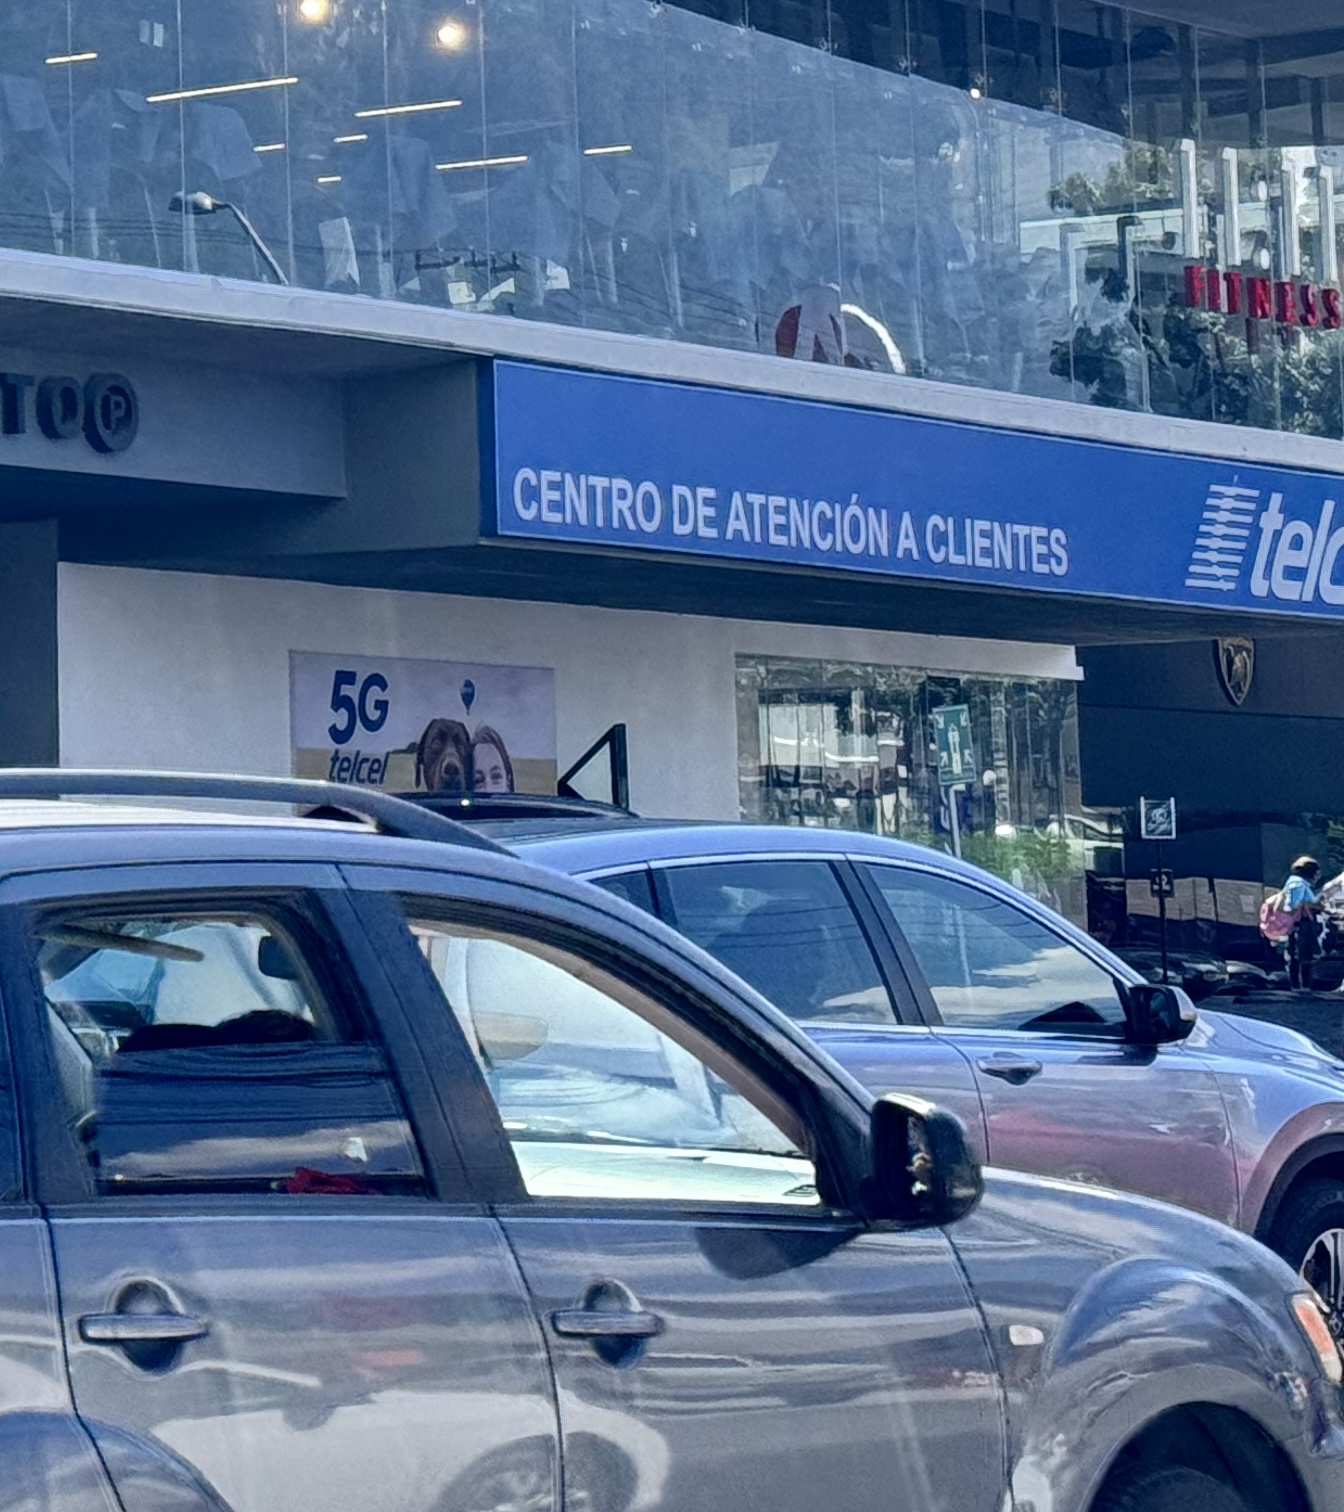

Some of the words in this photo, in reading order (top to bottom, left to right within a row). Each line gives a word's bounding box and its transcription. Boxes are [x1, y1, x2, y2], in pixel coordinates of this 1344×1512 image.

[1184, 265, 1342, 329] FITNESS
[513, 466, 662, 533] CENTRO
[672, 483, 719, 539] DE
[725, 491, 889, 558] ATENCIÓN
[896, 511, 920, 561] A
[925, 513, 1069, 576] CLIENTES
[328, 669, 390, 745] 5G
[328, 747, 392, 785] telcel
